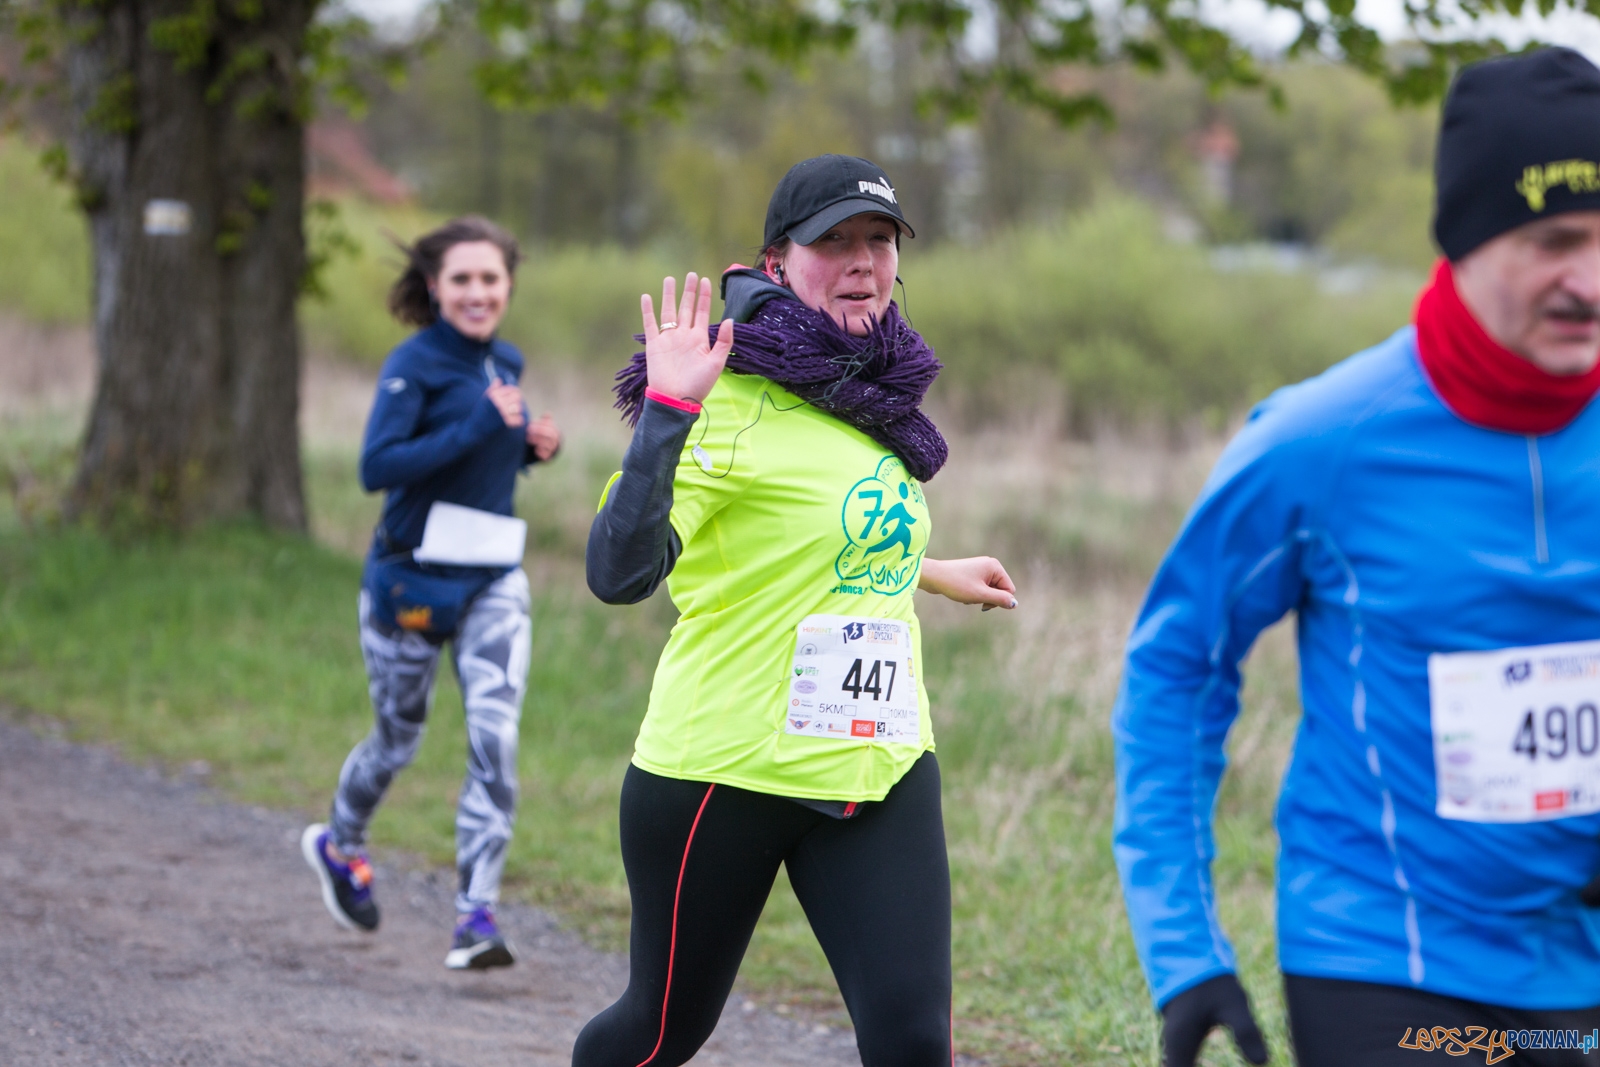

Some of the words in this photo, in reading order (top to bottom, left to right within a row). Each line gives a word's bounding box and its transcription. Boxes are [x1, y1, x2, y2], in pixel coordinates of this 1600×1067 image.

[842, 658, 897, 702] 447
[818, 703, 844, 715] 5KM
[890, 708, 908, 719] 10KM
[1514, 704, 1599, 762] 490
